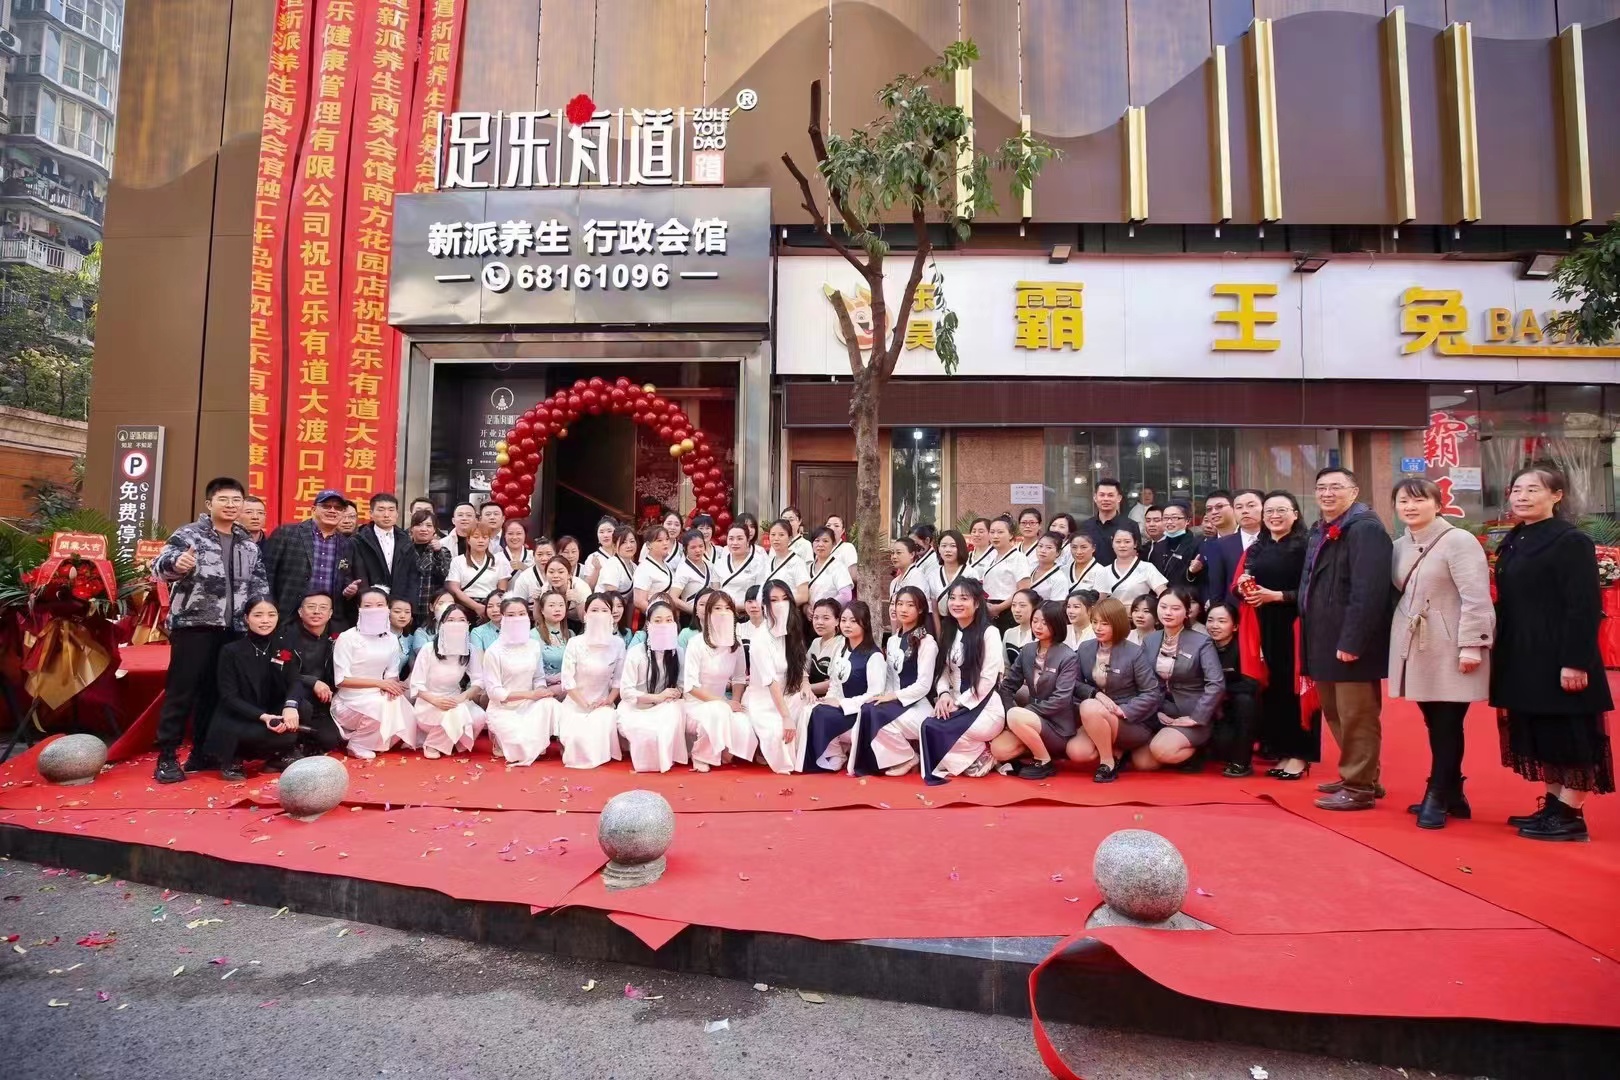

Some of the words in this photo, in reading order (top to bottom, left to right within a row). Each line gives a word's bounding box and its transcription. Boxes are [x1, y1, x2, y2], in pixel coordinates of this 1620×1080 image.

[692, 107, 730, 121] ZULE
[693, 121, 725, 135] YOU
[445, 108, 674, 187] 足乐有道
[693, 136, 726, 150] DAO
[427, 219, 570, 256] 新派养生
[582, 217, 729, 254] 行政会馆
[516, 263, 669, 289] 68161096
[130, 457, 142, 474] P
